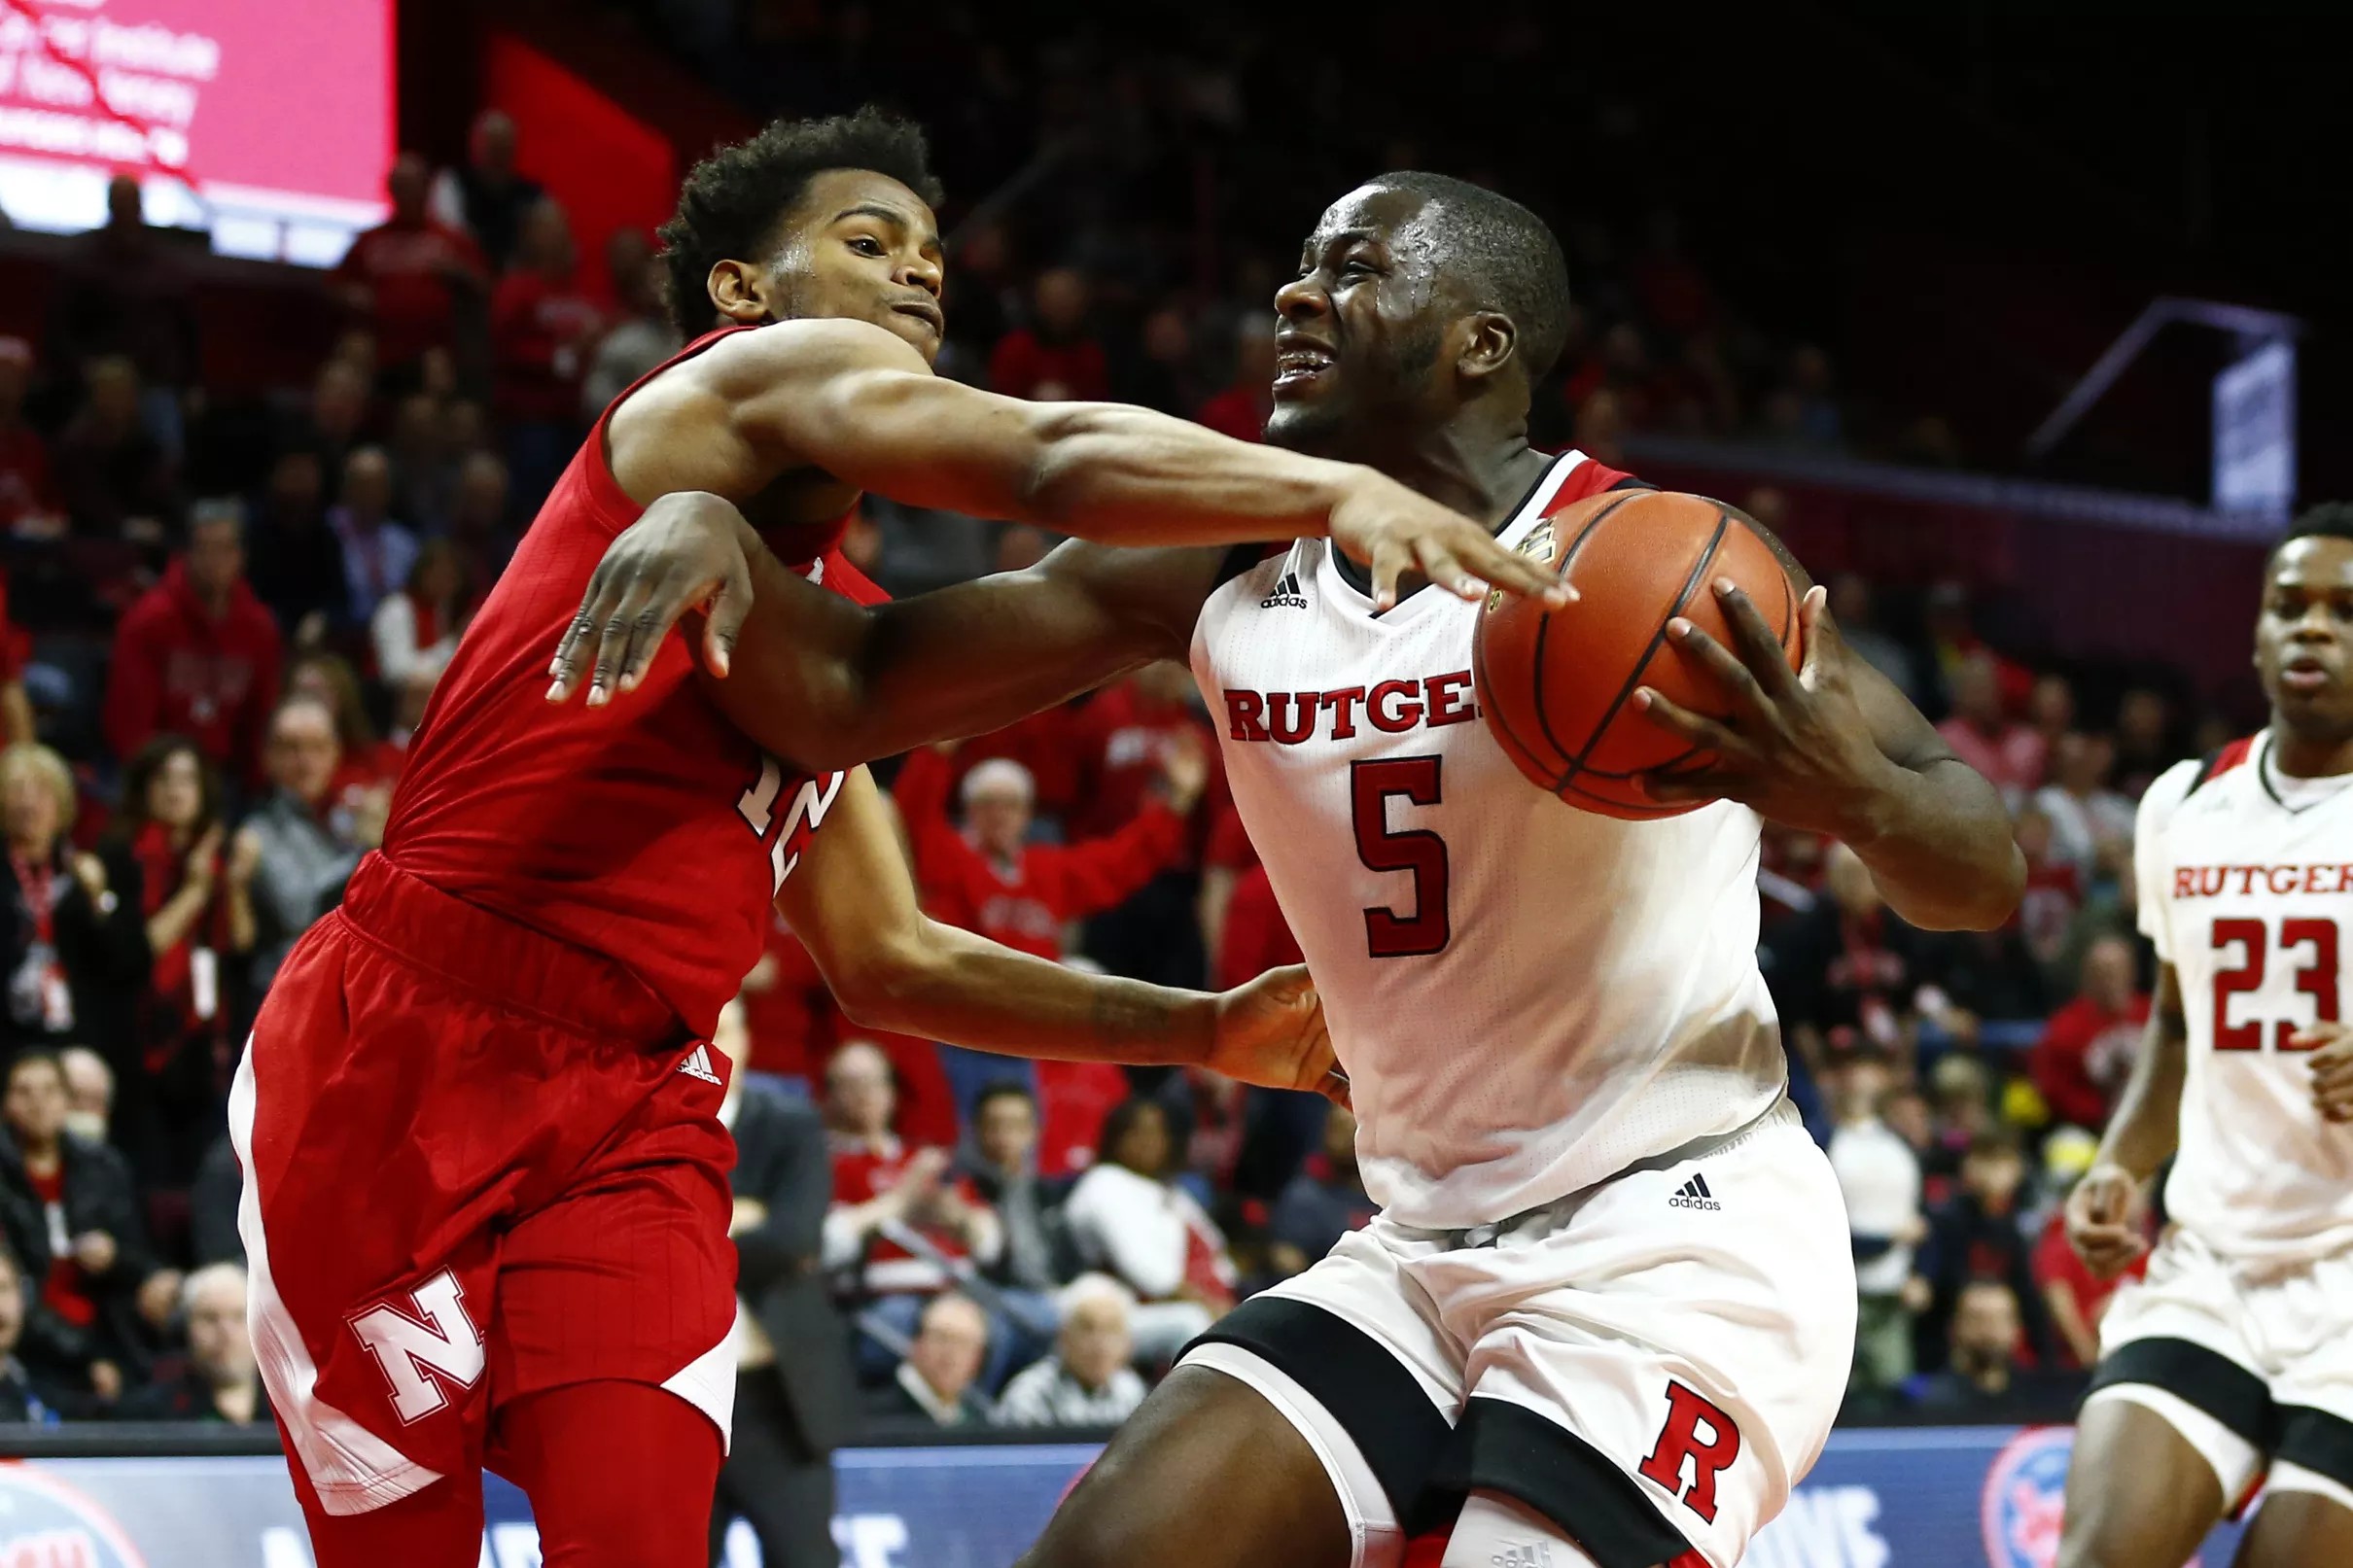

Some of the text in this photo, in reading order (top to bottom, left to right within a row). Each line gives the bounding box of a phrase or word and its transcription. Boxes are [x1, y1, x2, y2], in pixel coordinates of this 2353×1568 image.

[1260, 593, 1308, 610] adidas
[1223, 669, 1484, 746] RUTGE
[1351, 753, 1450, 959] 5
[2173, 863, 2353, 899] RUTGER
[2211, 916, 2340, 1052] 23
[675, 1064, 722, 1086] adidas
[1668, 1195, 1721, 1211] adidas
[346, 1264, 486, 1427] N
[1637, 1378, 1740, 1526] R
